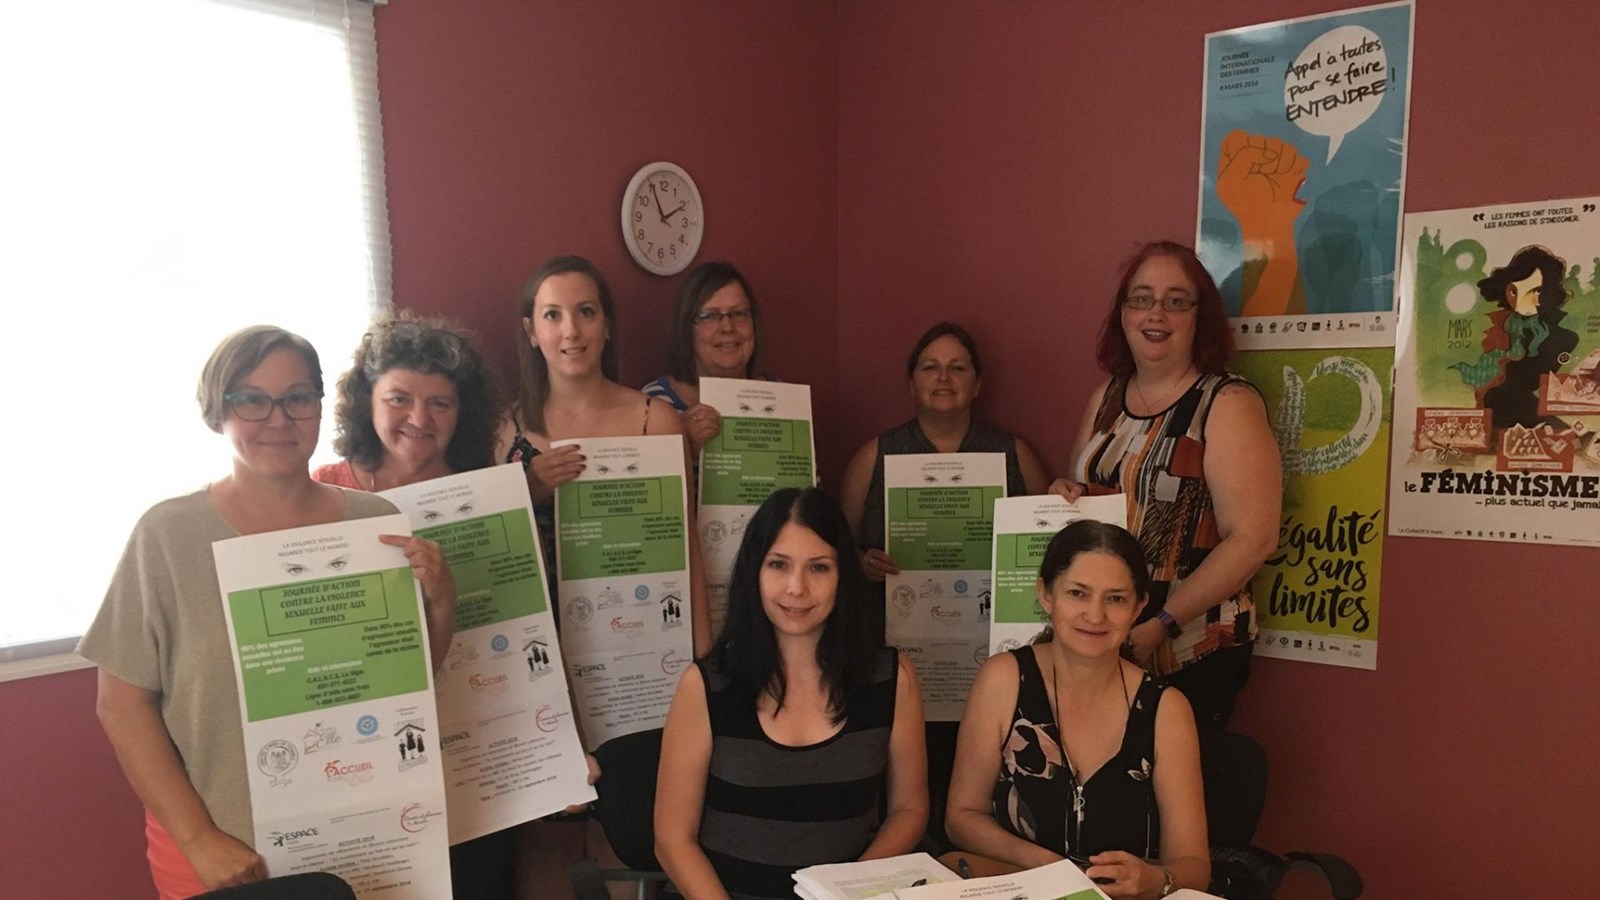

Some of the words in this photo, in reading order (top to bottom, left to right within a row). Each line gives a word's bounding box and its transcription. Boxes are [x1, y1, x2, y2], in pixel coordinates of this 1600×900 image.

[1220, 56, 1275, 71] INTERNATIONALE
[1221, 52, 1249, 63] JOURNÉE
[1285, 53, 1321, 81] Appel
[1340, 37, 1382, 61] toutes
[1220, 71, 1234, 79] DES
[1236, 67, 1260, 77] FEMMES
[1325, 72, 1341, 86] se
[1344, 62, 1385, 85] faire
[1225, 82, 1244, 90] MARS
[659, 181, 669, 192] 12
[673, 188, 677, 198] 1
[639, 195, 649, 207] 10
[680, 200, 687, 212] 2
[635, 211, 642, 223] 9
[1491, 213, 1503, 221] LES
[1533, 209, 1546, 217] ONT
[1548, 207, 1574, 215] TOUTES
[682, 218, 689, 229] 3
[1498, 219, 1528, 227] RAISONS
[639, 229, 645, 241] 8
[679, 234, 685, 244] 4
[648, 242, 654, 253] 7
[658, 248, 665, 259] 6
[670, 244, 677, 256] 5
[1448, 319, 1474, 339] MARS
[1448, 341, 1473, 349] 2012
[1404, 480, 1417, 494] le
[1485, 498, 1507, 507] plus
[1510, 499, 1545, 507] actuel
[1548, 500, 1569, 510] que
[1303, 556, 1368, 592] sans
[283, 585, 321, 598] JOURNÉE
[323, 580, 361, 592] D'ACTION
[281, 597, 314, 609] CONTRE
[315, 594, 326, 603] LA
[327, 589, 367, 602] VIOLENCE
[1269, 572, 1371, 633] limites
[285, 605, 325, 619] SEXUELLE
[326, 602, 349, 613] FAITE
[350, 600, 366, 609] AUX
[310, 614, 346, 625] FEMMES
[284, 827, 320, 842] ESPACE
